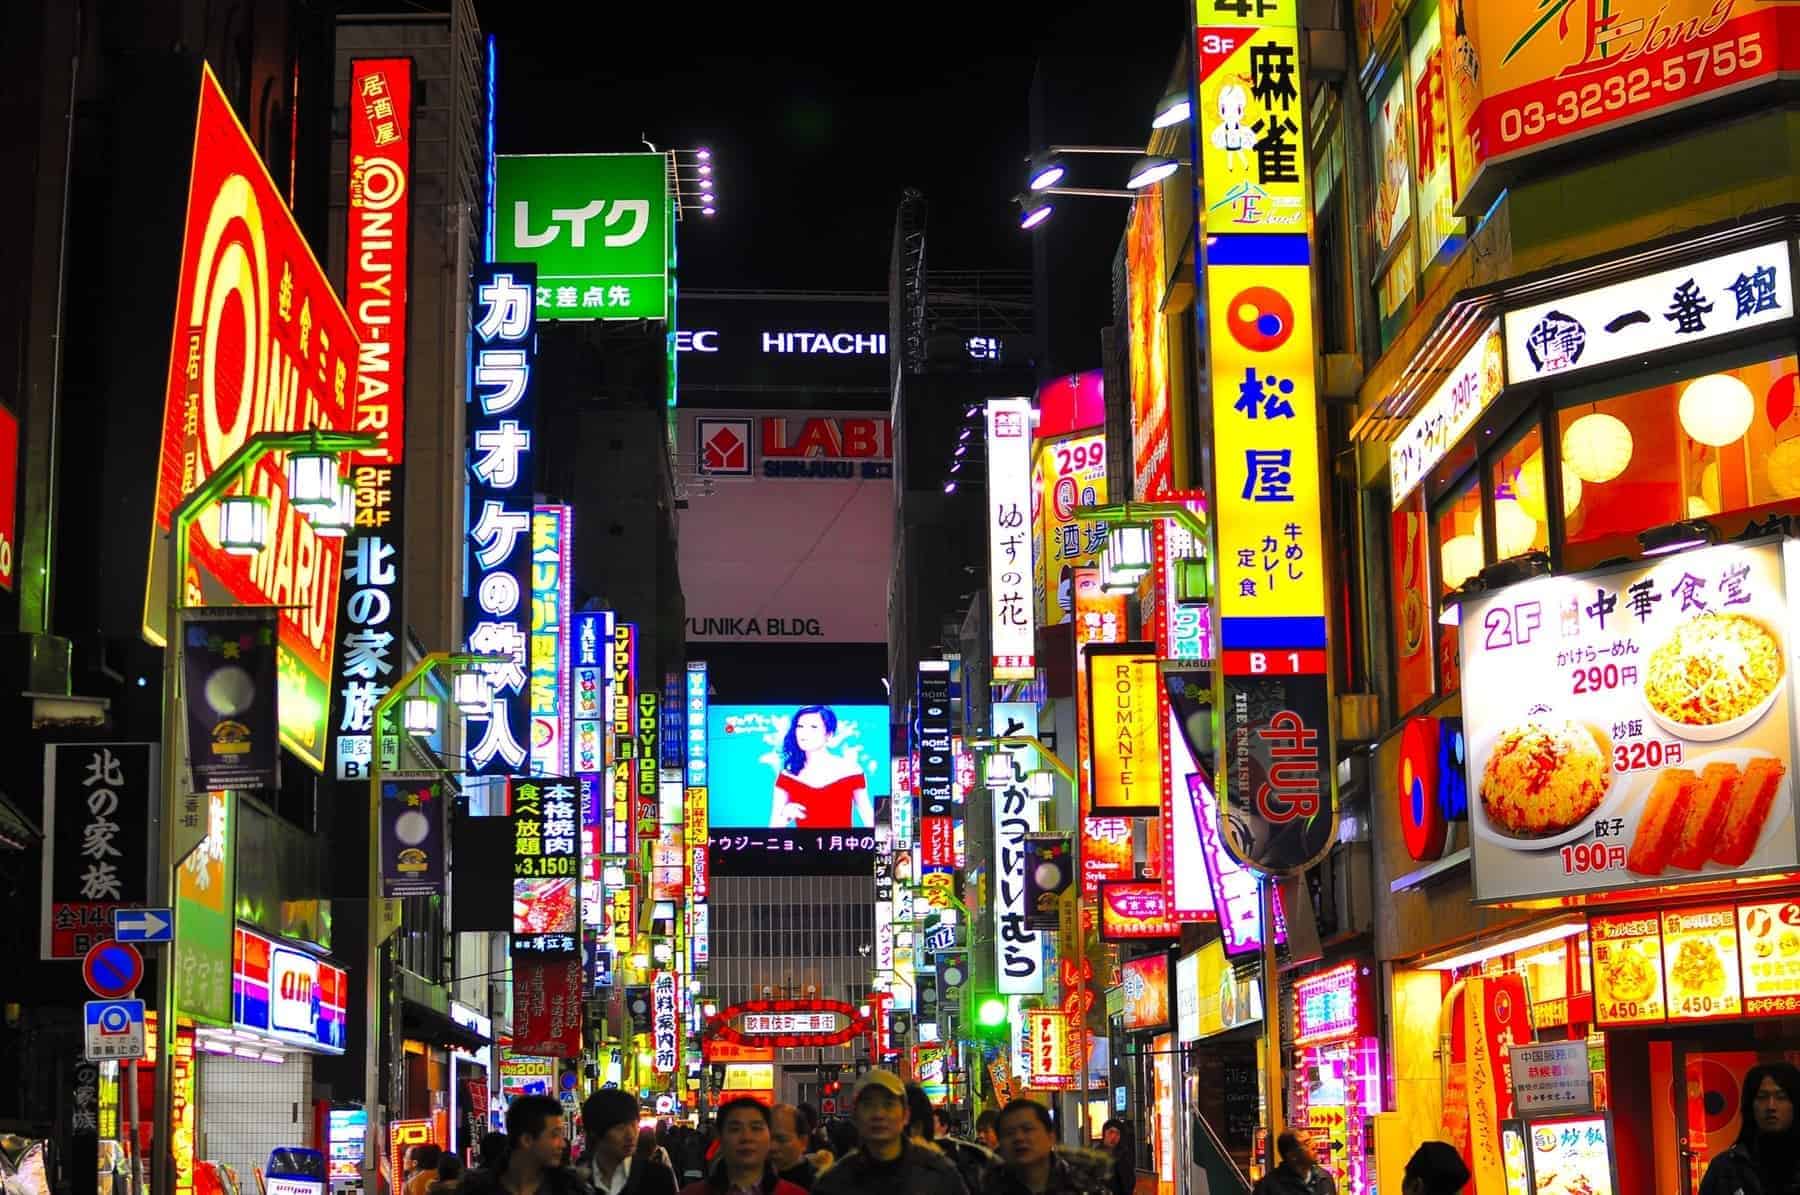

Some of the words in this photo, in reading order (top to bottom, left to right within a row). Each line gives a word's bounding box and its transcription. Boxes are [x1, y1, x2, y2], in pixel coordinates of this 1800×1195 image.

[1202, 35, 1235, 54] 3F
[361, 74, 400, 145] 居酒屋
[1500, 32, 1764, 143] 03-3232-5755
[1250, 41, 1299, 185] 麻雀
[513, 199, 650, 248] レイク
[1603, 265, 1782, 346] 一番館
[667, 331, 718, 352] EC
[762, 332, 887, 354] HITACHI
[1056, 442, 1104, 476] 299
[1233, 367, 1296, 503] 松屋
[355, 467, 391, 486] 2F
[355, 487, 391, 507] 3F
[355, 510, 391, 528] 4F
[472, 273, 532, 771] カラオケの鉄人
[1055, 523, 1109, 561] 酒場
[998, 503, 1027, 628] ゆずの花
[1236, 548, 1258, 598] 定食
[1261, 535, 1279, 591] カレー
[1284, 523, 1304, 581] 牛めし
[1586, 563, 1752, 631] 中華食堂
[341, 535, 397, 733] 北の家族
[766, 617, 826, 637] BLDG.
[1484, 601, 1542, 650] 2F
[1556, 638, 1640, 667] かけらーめん
[1572, 663, 1639, 695] 290円
[341, 736, 395, 756] 個室備
[1115, 665, 1135, 801] ROUMANTEI
[1611, 719, 1643, 740] 炒飯
[1256, 710, 1320, 824] HUB
[1613, 740, 1684, 772] 320円
[80, 749, 124, 900] 北の家族
[514, 783, 542, 856] 食べ放題
[543, 783, 576, 855] 本格焼肉
[1594, 817, 1625, 838] 餃子
[515, 857, 568, 876] ¥3,150
[1561, 843, 1627, 875] 190円
[655, 975, 674, 1067] 無料案内所
